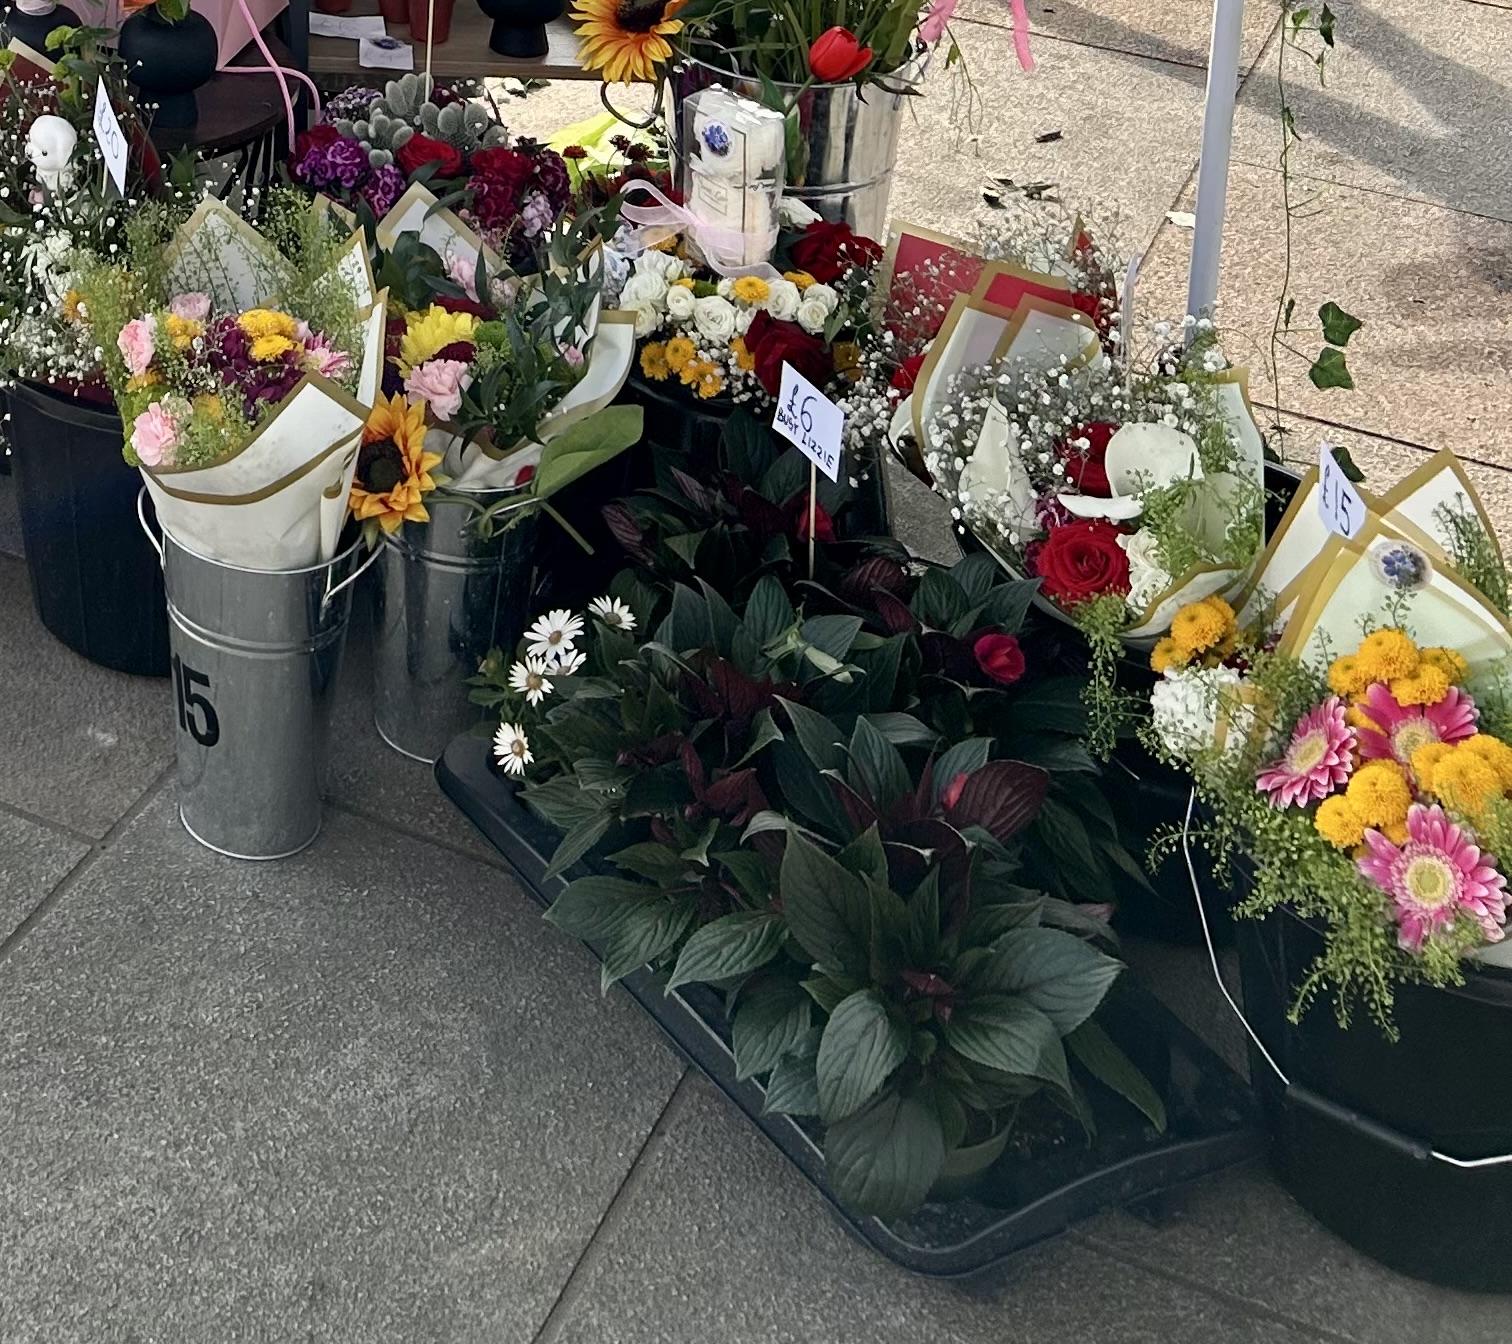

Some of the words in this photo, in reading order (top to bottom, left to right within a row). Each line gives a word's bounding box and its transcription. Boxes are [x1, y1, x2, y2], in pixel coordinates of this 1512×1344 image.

[787, 384, 818, 433] £6
[801, 432, 835, 470] LIZZIE
[1322, 464, 1352, 537] £15
[172, 652, 220, 748] 15
